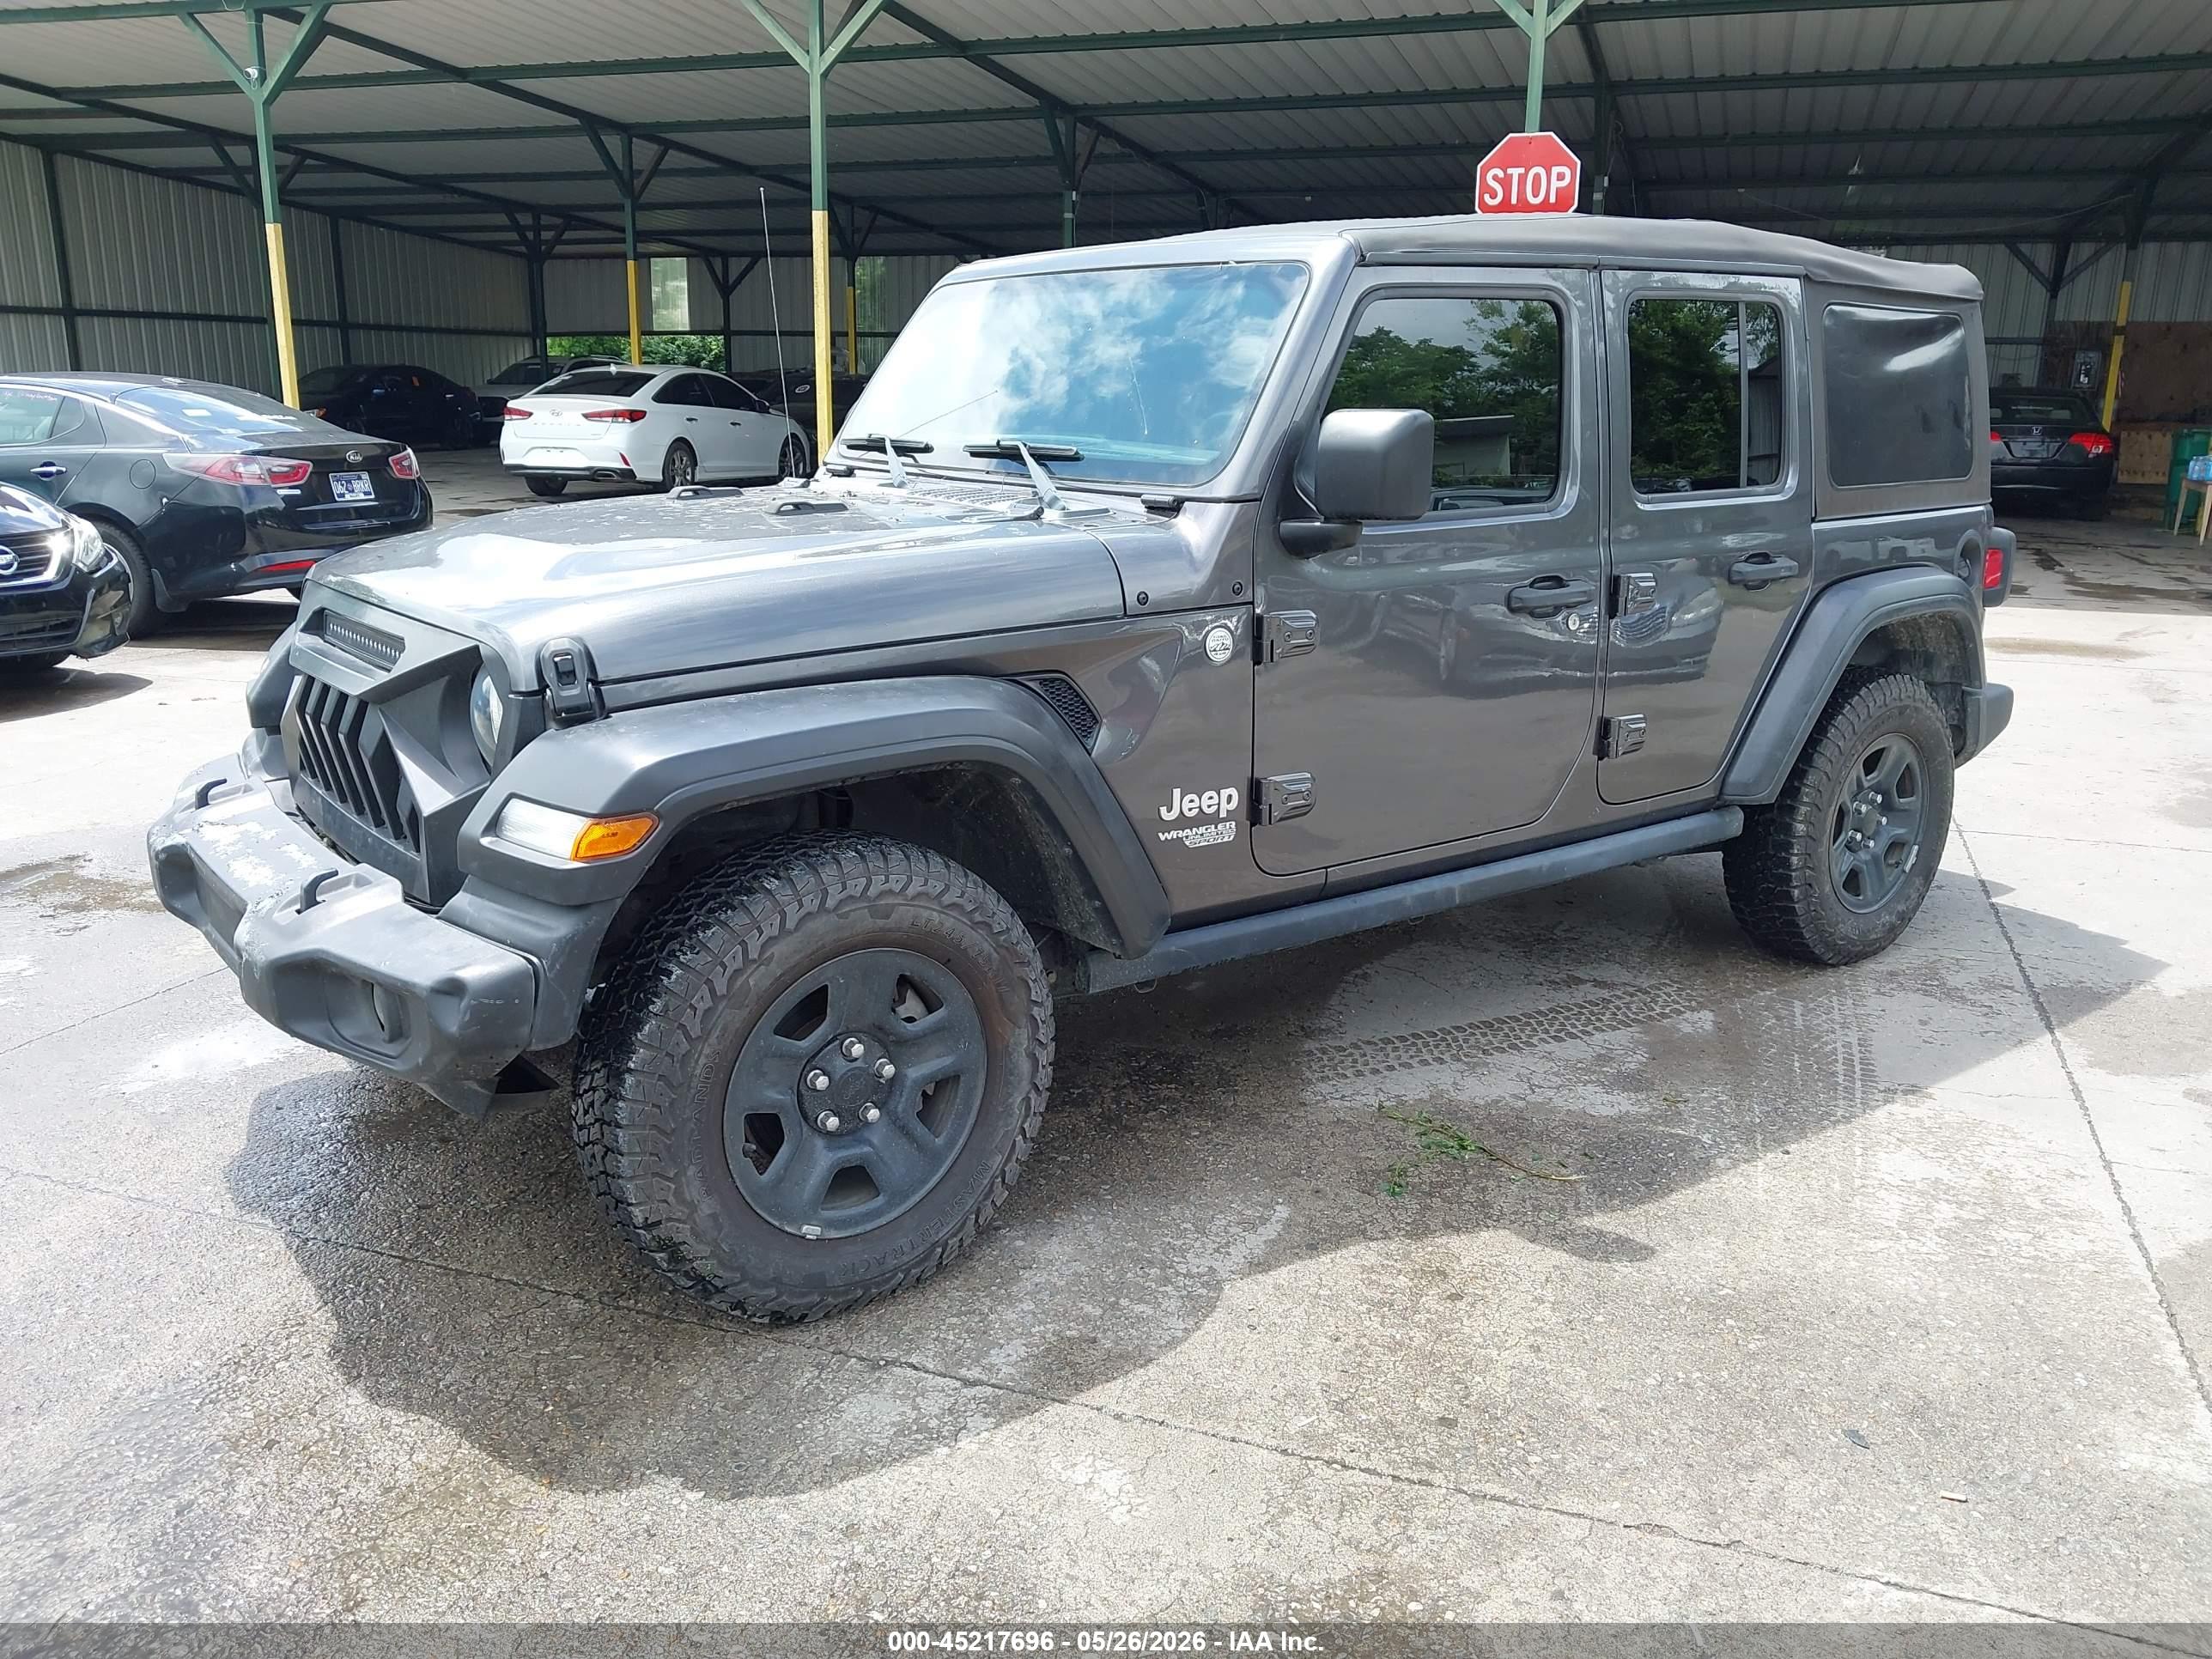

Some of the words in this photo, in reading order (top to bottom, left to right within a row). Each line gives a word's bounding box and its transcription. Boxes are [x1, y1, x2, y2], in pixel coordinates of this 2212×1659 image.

[1483, 166, 1571, 206] STOP
[1159, 787, 1238, 821] Jeep
[1158, 821, 1237, 841] WRANGLER
[1182, 829, 1237, 841] UNLIMITED
